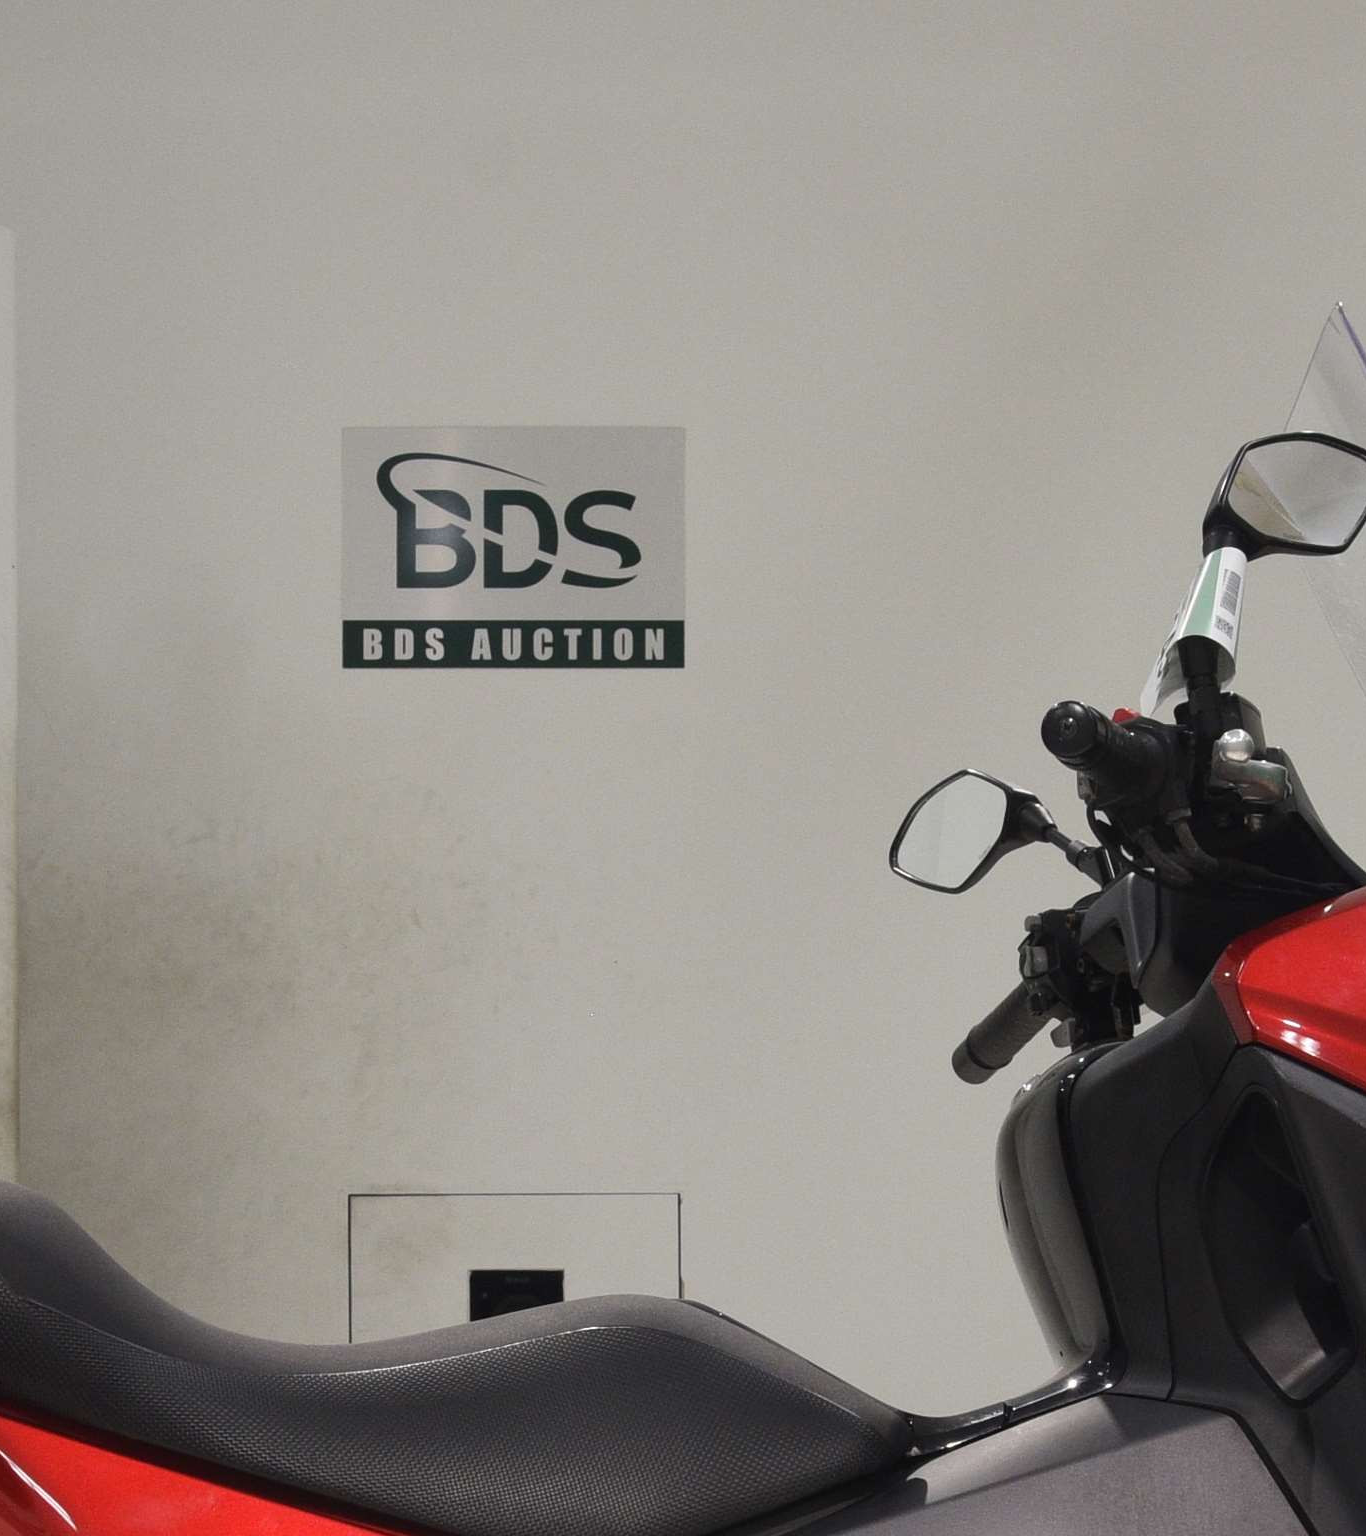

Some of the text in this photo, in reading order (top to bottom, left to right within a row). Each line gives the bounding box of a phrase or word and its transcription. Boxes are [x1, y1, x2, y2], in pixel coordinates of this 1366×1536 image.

[376, 453, 641, 588] BDS
[362, 627, 664, 661] BDS AUCTION
